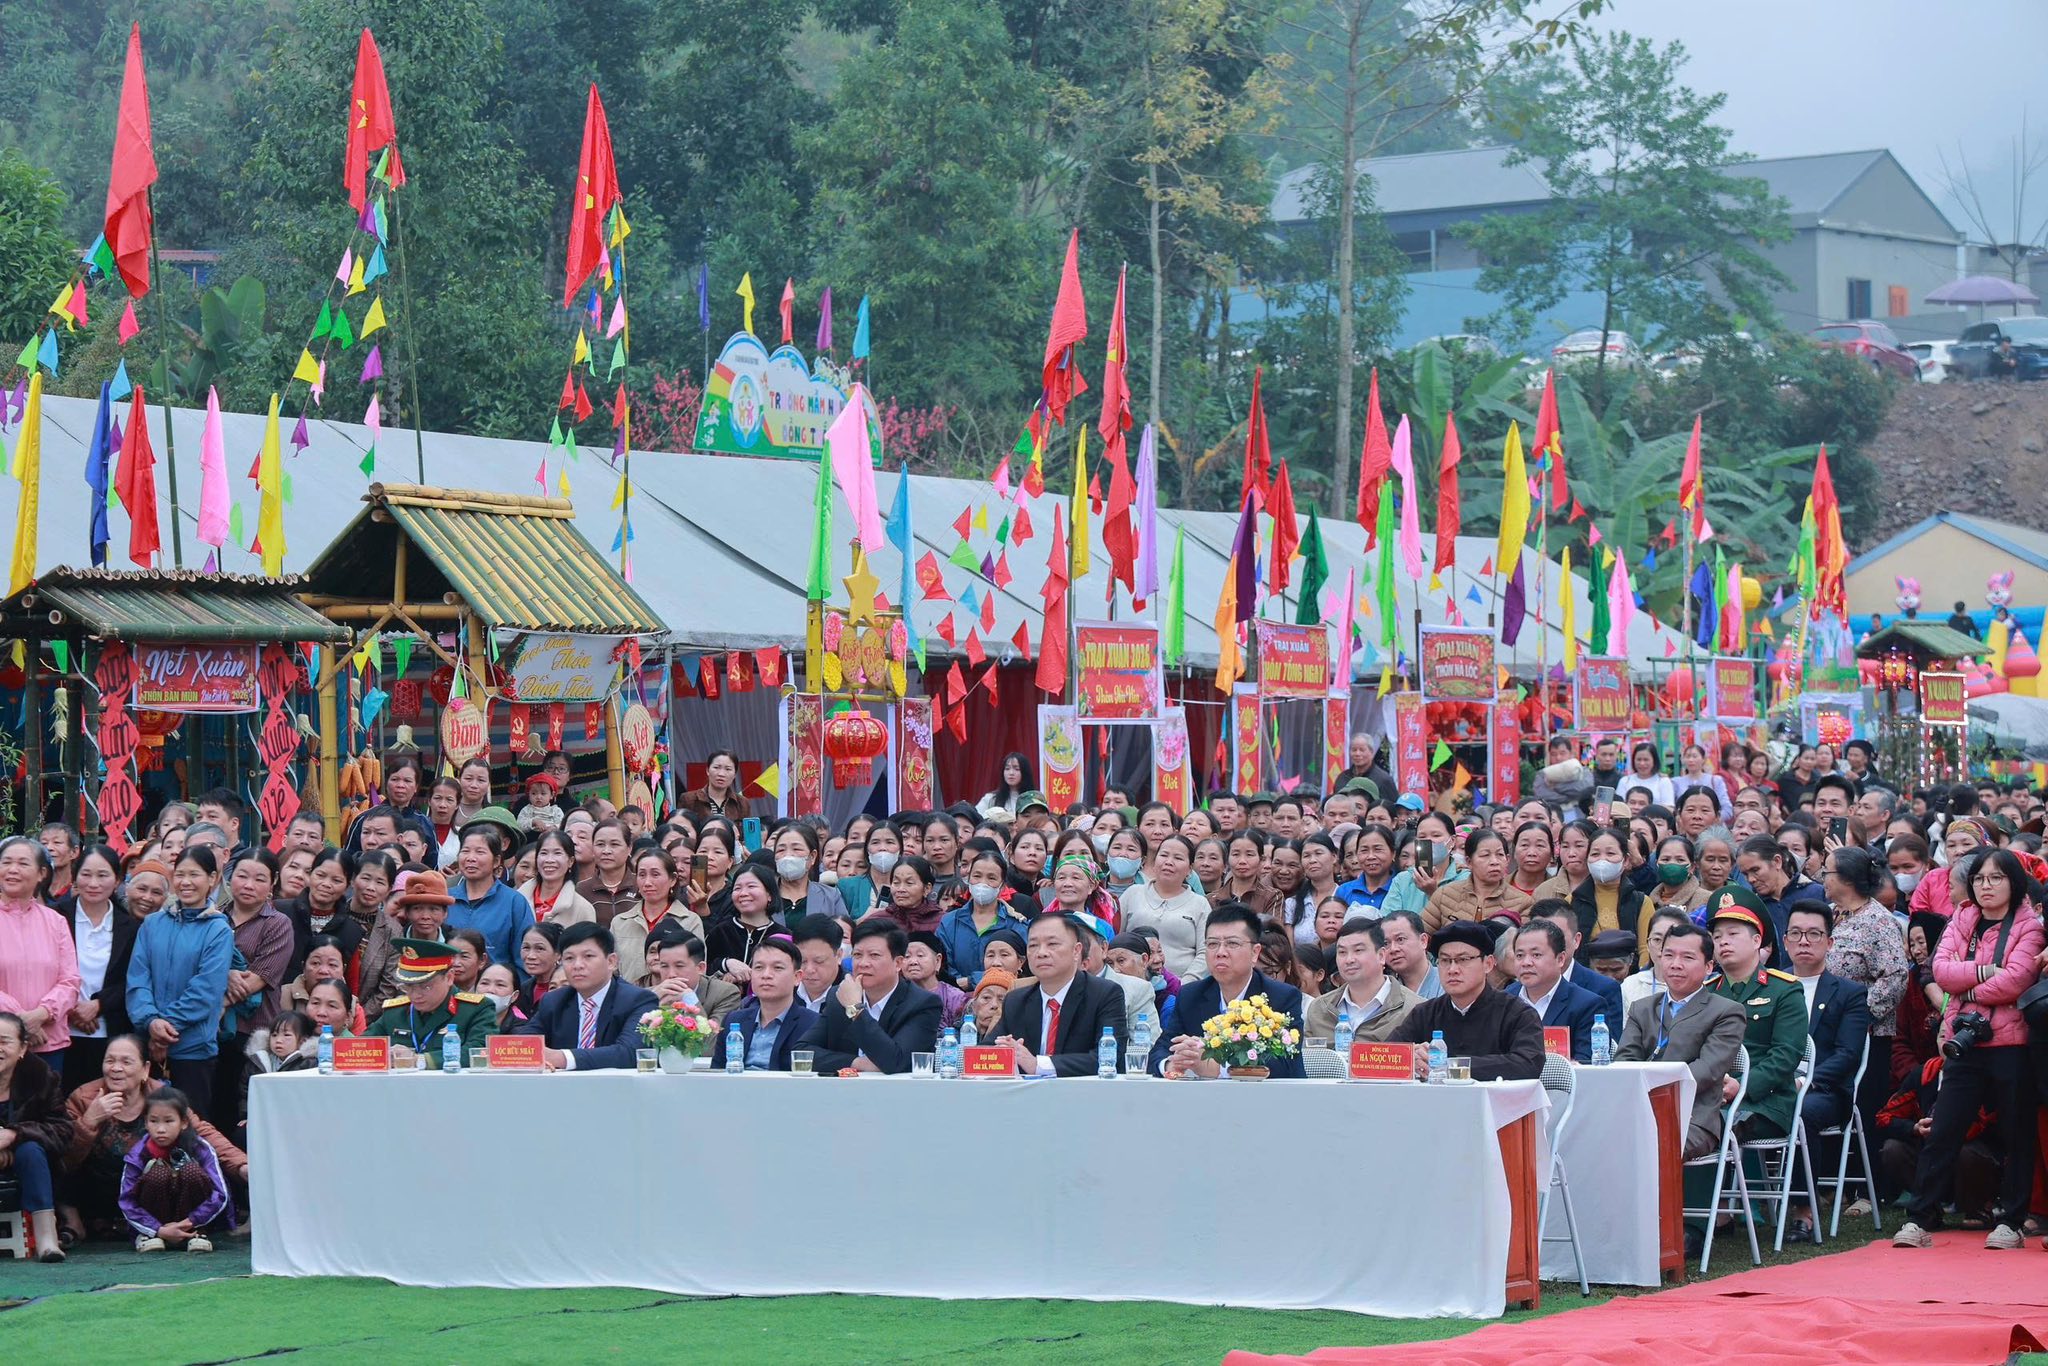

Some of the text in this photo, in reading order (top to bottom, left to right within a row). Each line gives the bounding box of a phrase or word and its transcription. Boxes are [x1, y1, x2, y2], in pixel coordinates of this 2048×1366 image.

[1085, 642, 1106, 675] TRẠI
[1107, 635, 1130, 669] XUÂN
[1273, 640, 1310, 653] TRẠI XUÂN
[1455, 639, 1480, 660] XUÂN
[145, 646, 247, 687] Nét Xuân
[1434, 661, 1454, 679] THÔN
[143, 688, 162, 702] THÔN
[1052, 777, 1071, 799] Lộc
[1359, 1051, 1402, 1065] HÀ NGỌC VIỆT
